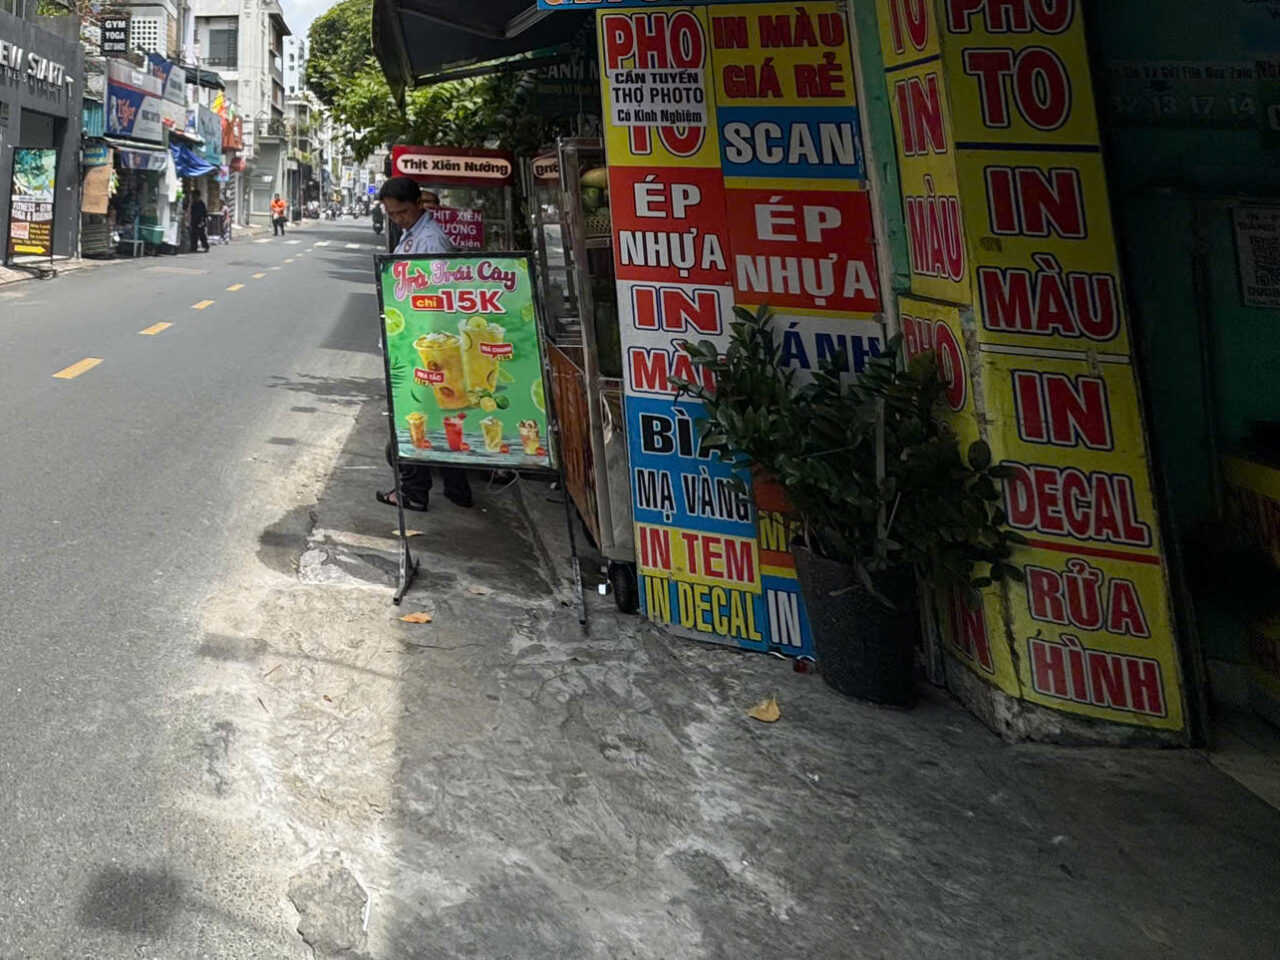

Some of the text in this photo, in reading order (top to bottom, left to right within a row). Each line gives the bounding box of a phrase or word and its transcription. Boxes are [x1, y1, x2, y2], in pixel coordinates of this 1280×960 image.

[104, 31, 126, 40] YOGA
[105, 20, 126, 29] GYM
[602, 9, 706, 76] PHO
[712, 6, 846, 49] IN MÀU
[26, 51, 66, 87] START
[650, 69, 699, 84] TUYỂN
[722, 50, 847, 100] GIÁ RẺ
[962, 44, 1072, 133] TO
[612, 84, 644, 107] THỢ
[650, 87, 704, 104] PHOTO
[617, 108, 702, 125] Có Kinh Nghiệm
[893, 72, 949, 158] IN
[401, 157, 509, 176] Thịt Xiên Nướng
[722, 120, 857, 165] SCAN
[456, 209, 483, 222] XIÊN
[632, 173, 703, 221] ÉP
[753, 195, 843, 243] ÉP
[984, 165, 1087, 240] IN
[618, 226, 729, 279] NHỰA
[905, 174, 967, 284] MÀU
[392, 260, 517, 300] Trà Trái Cây
[439, 289, 505, 313] 15K
[734, 252, 877, 307] NHỰA
[976, 252, 1121, 342] MÀU
[631, 285, 722, 336] IN
[1013, 369, 1113, 452] IN
[634, 464, 753, 524] MẠ VÀNG
[1000, 460, 1152, 547] DECAL
[638, 524, 671, 572] IN
[683, 531, 756, 586] TEM
[644, 574, 764, 643] IN DECAL
[765, 587, 803, 649] IN
[1023, 558, 1152, 640] RỬA
[1028, 632, 1168, 719] HÌNH
